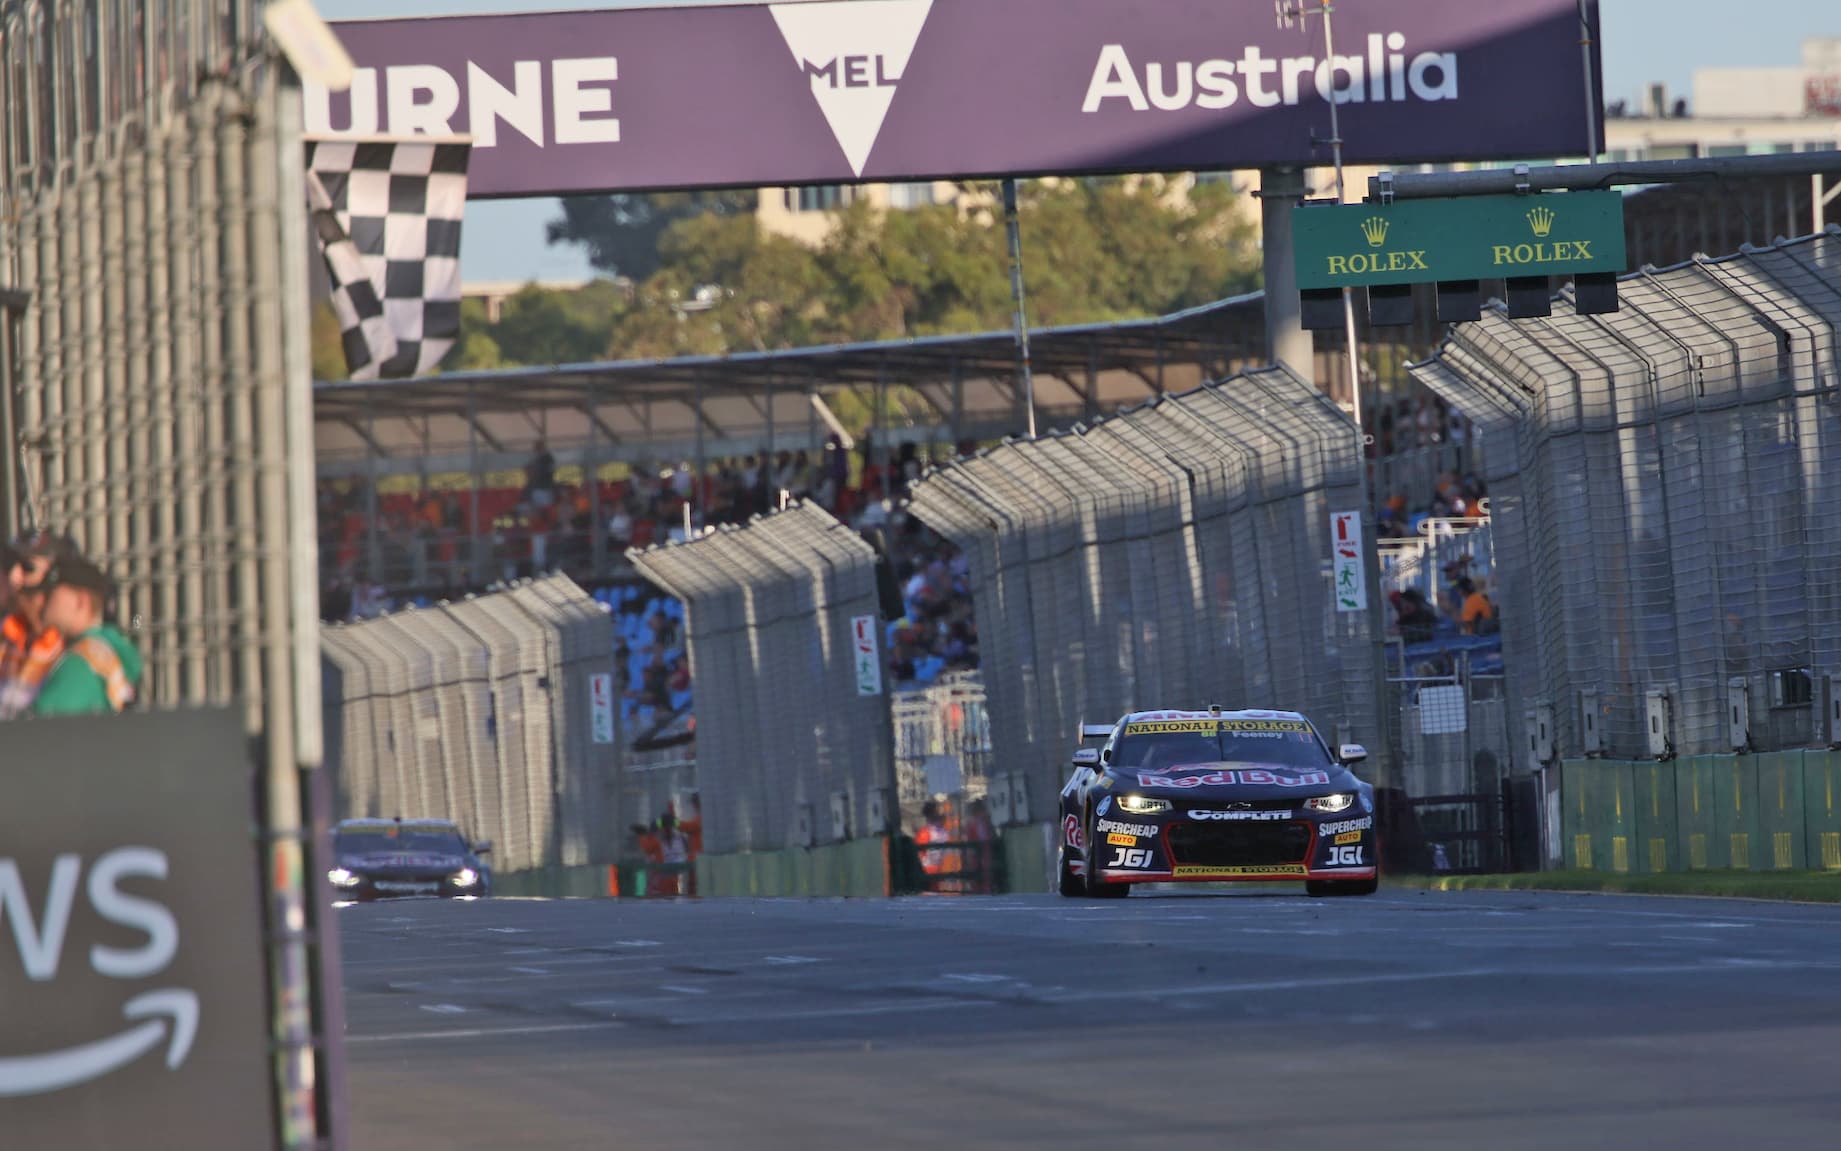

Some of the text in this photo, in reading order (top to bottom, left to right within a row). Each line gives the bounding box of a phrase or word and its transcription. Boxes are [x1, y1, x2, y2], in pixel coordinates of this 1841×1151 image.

[802, 54, 901, 88] MEL
[1082, 32, 1458, 113] Australia
[1327, 249, 1429, 275] ROLEX
[1492, 240, 1594, 265] ROLEX
[1128, 720, 1304, 734] NATIONAL STORAGE
[1231, 731, 1284, 739] Feeney
[1137, 770, 1330, 789] Red Bull
[1187, 809, 1293, 820] COMPLETE
[1096, 818, 1159, 839] SUPERCHEAP
[1318, 815, 1373, 837] SUPERCHEAP
[1110, 835, 1134, 844] AUTO
[1337, 833, 1359, 842] AUTO
[1107, 847, 1154, 868] JGI
[1325, 845, 1364, 866] JGI
[1176, 865, 1305, 874] NATIONAL STORAGE
